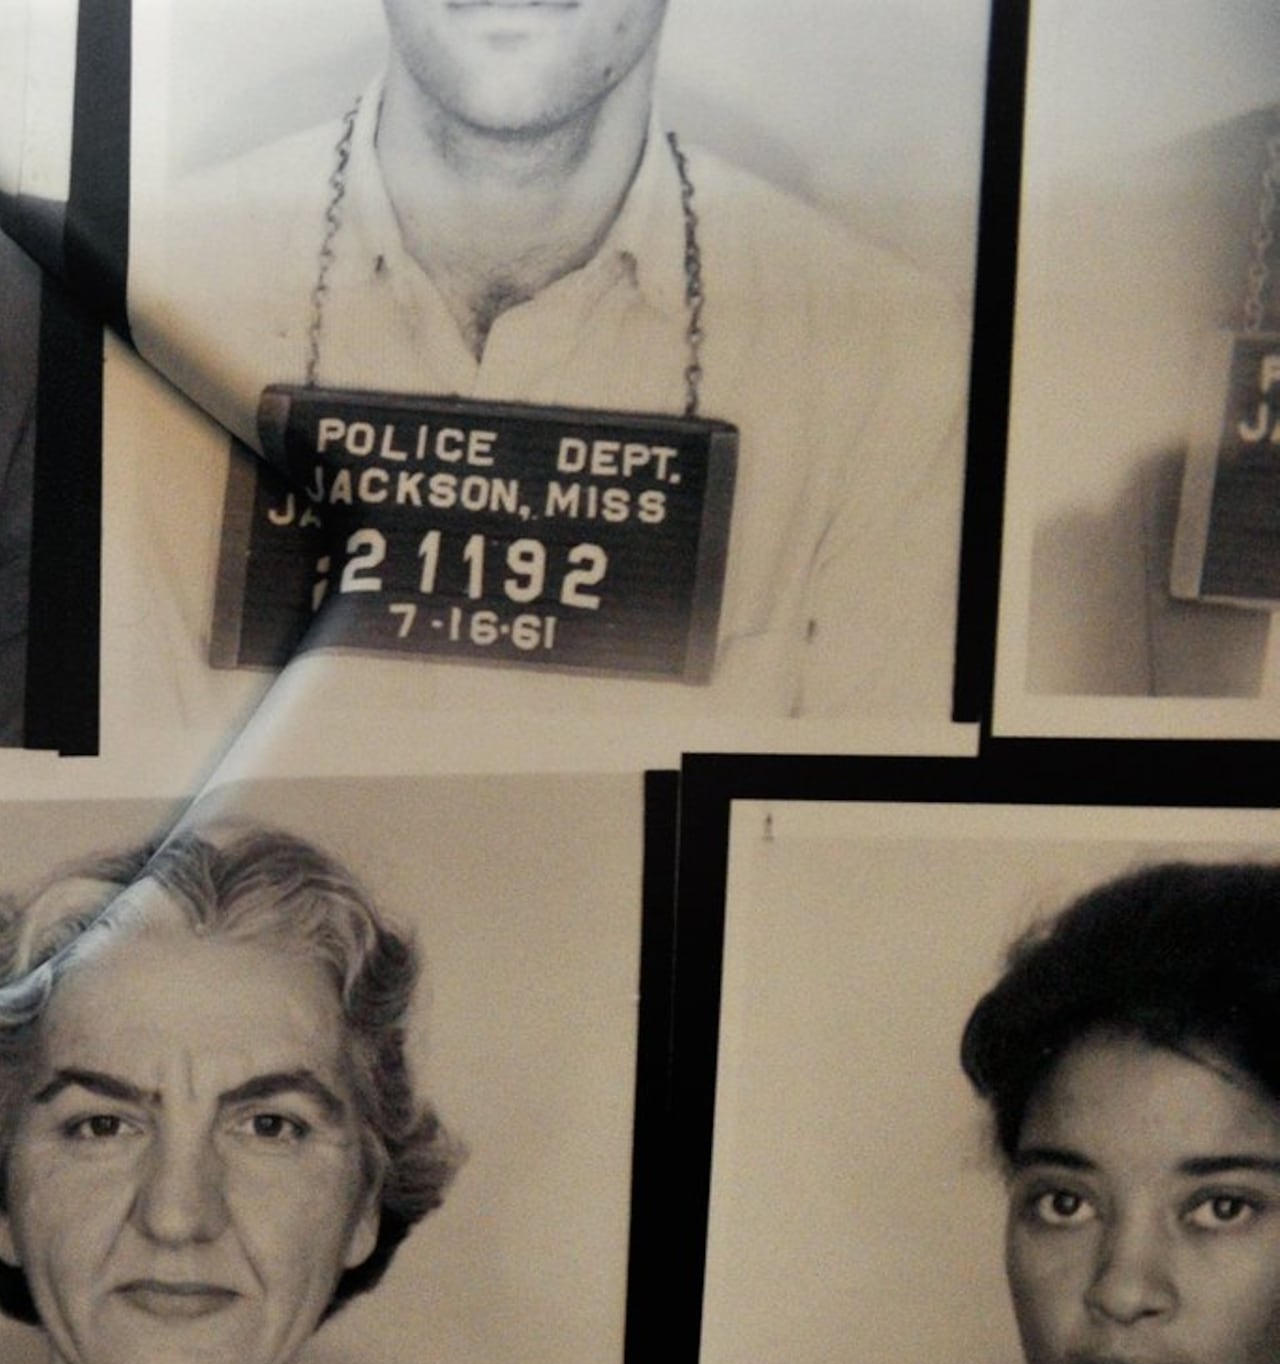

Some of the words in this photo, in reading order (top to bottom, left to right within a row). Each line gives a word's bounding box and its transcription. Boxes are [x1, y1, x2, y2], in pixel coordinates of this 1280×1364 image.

[317, 417, 497, 467] POLICE
[556, 437, 682, 484] DEPT.
[306, 464, 531, 522] JACKSON,
[545, 482, 668, 525] MISS
[341, 527, 608, 610] 21192
